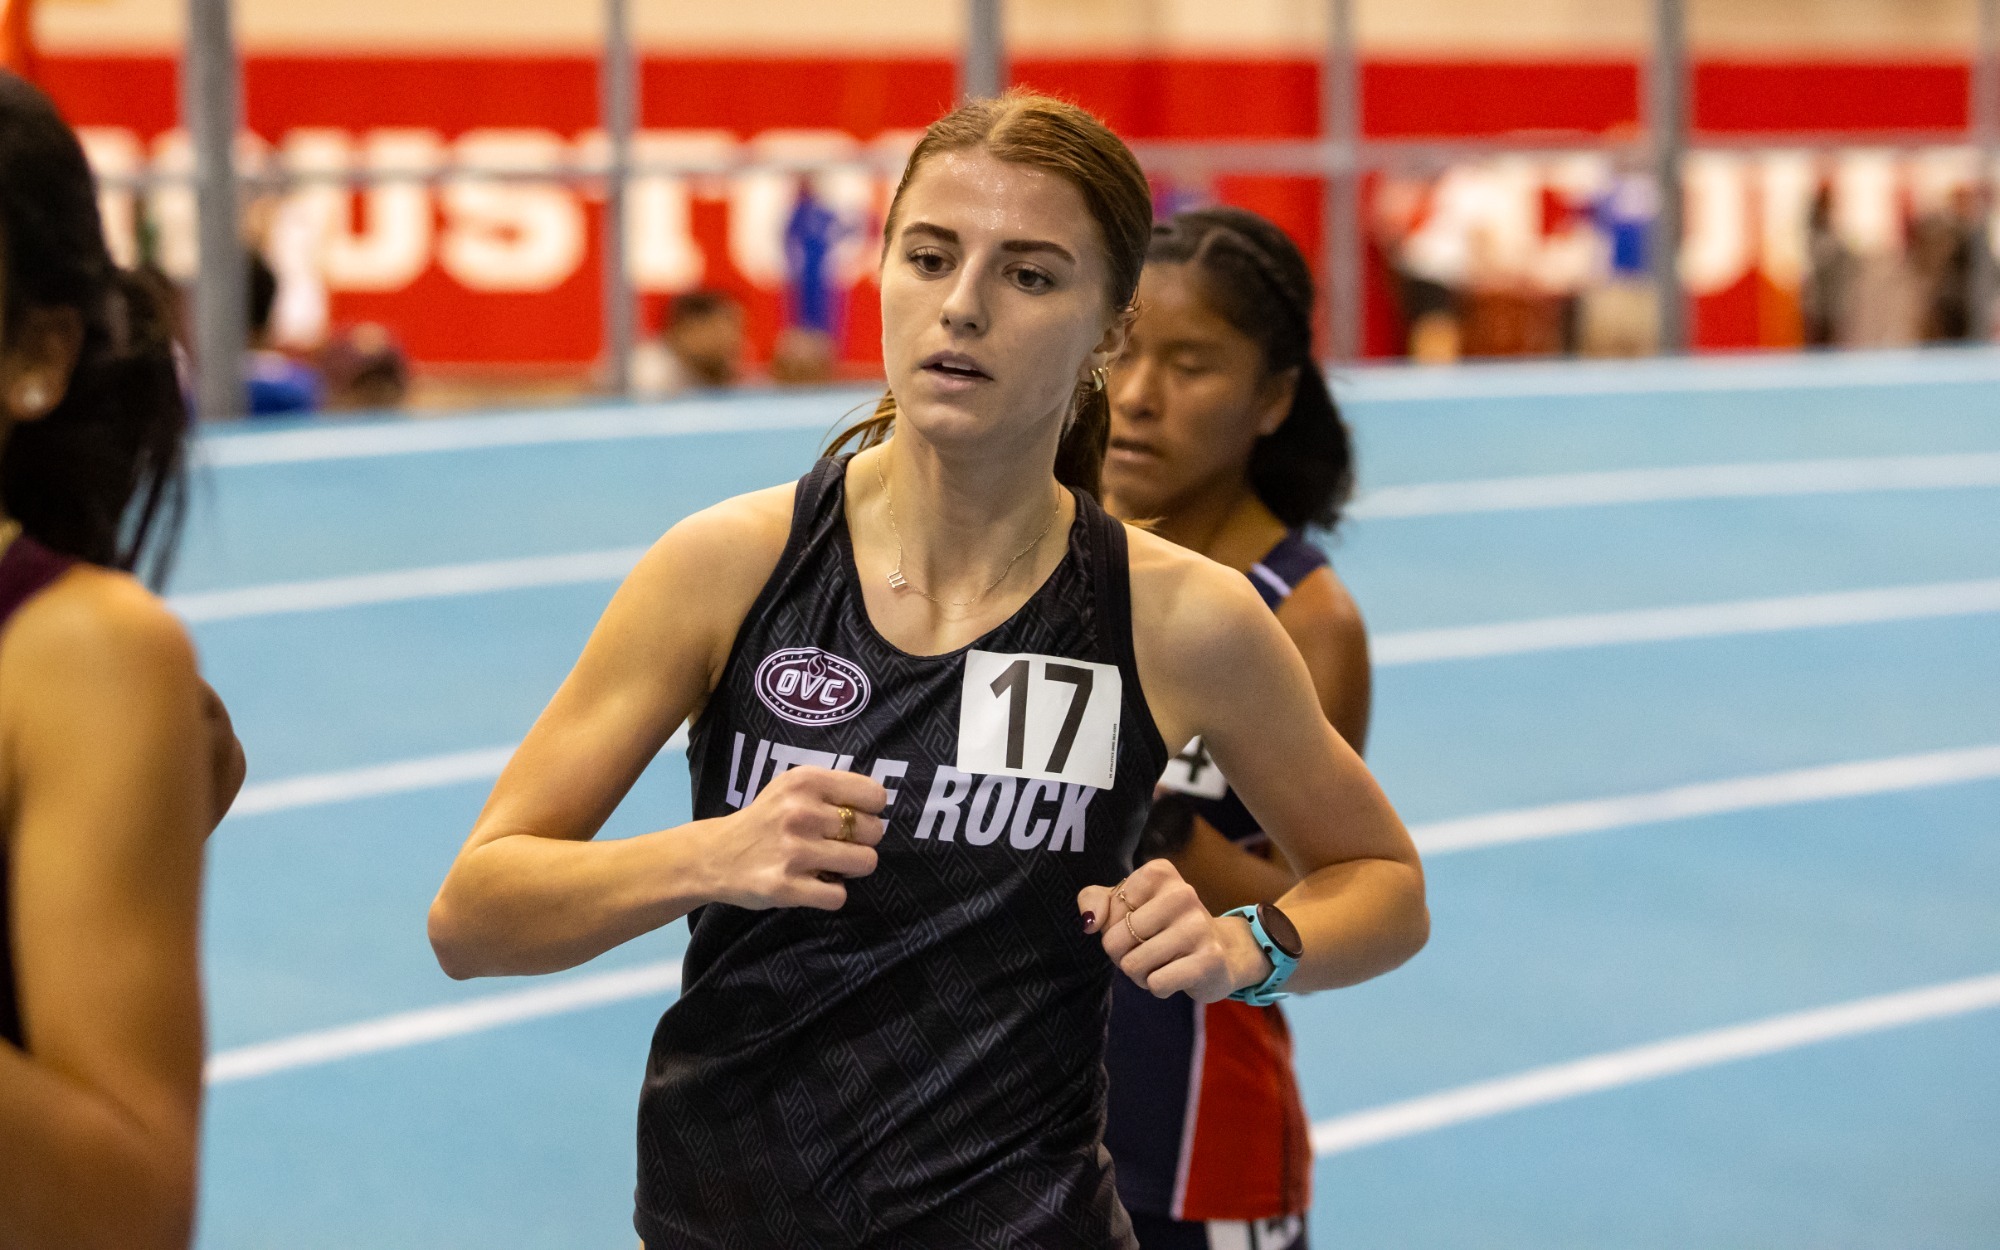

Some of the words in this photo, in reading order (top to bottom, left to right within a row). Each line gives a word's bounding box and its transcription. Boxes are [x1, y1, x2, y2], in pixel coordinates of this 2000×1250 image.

[772, 654, 803, 666] OHIO
[827, 660, 863, 688] VALLEY
[776, 668, 845, 706] OVC
[768, 695, 847, 720] CONFERENCE
[989, 659, 1094, 774] 17
[914, 764, 1098, 852] ROCK
